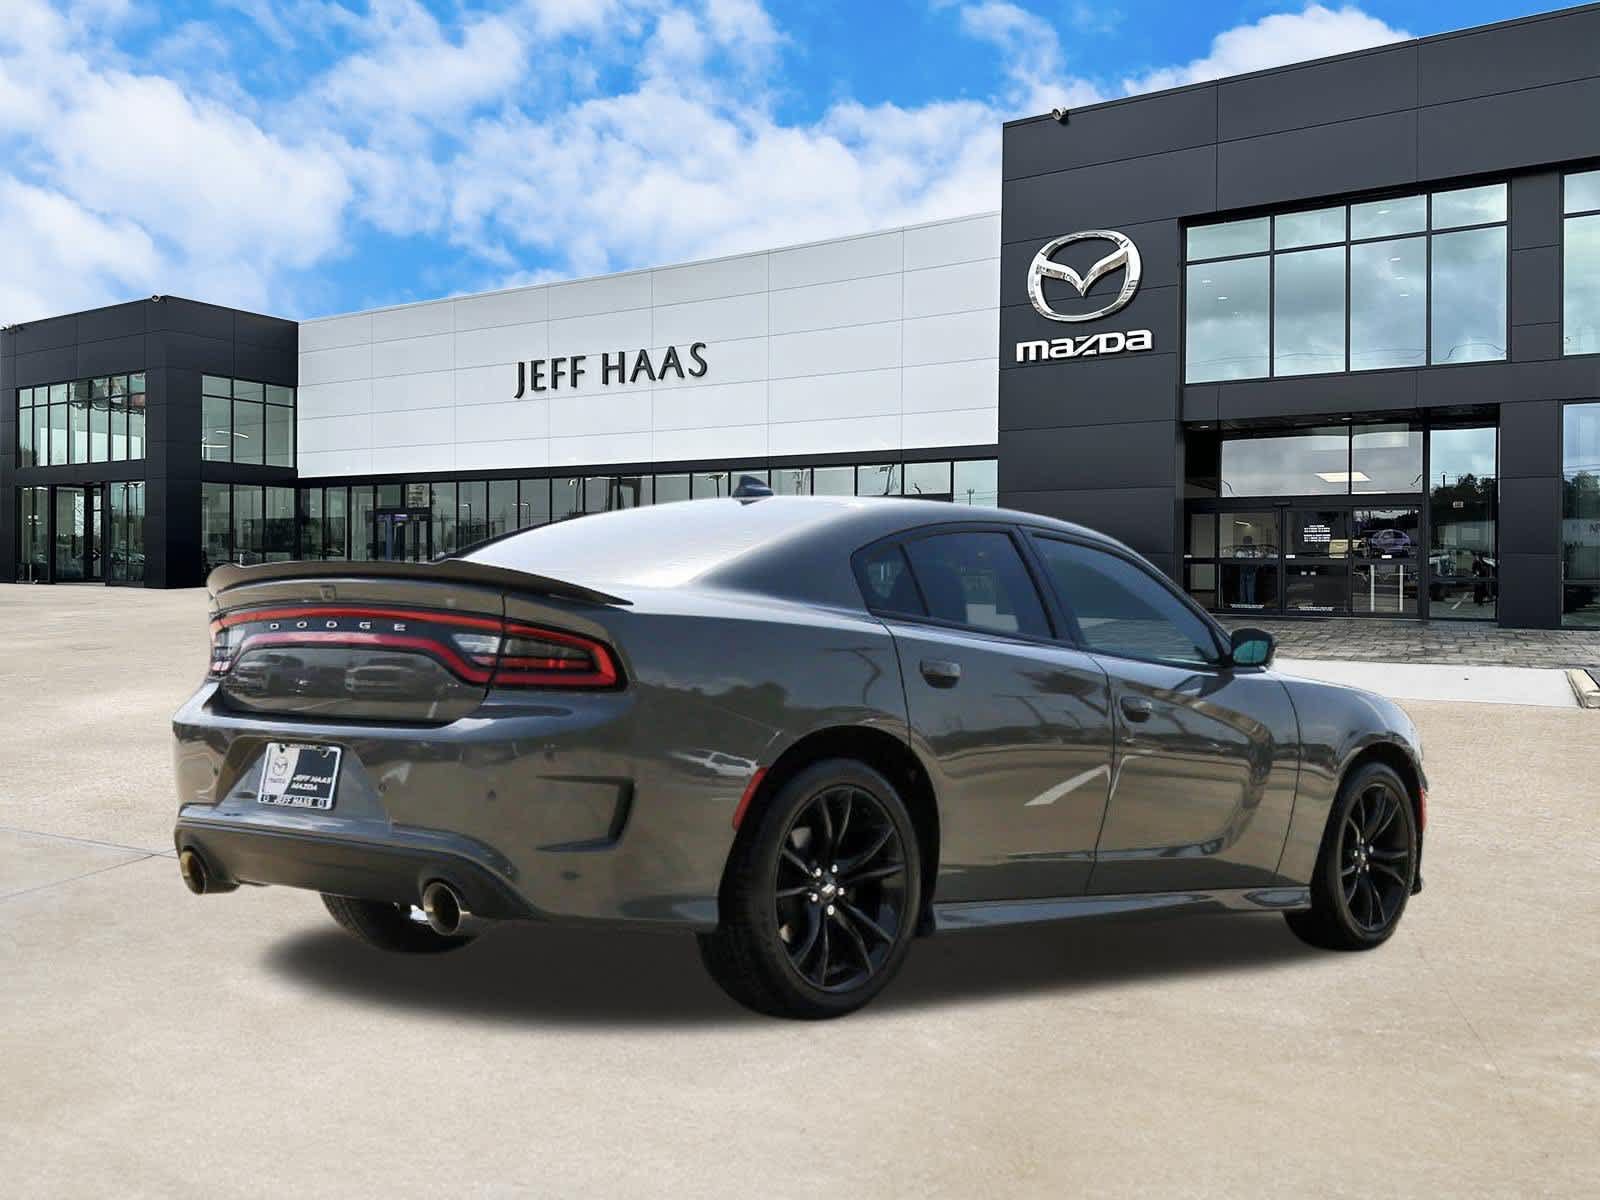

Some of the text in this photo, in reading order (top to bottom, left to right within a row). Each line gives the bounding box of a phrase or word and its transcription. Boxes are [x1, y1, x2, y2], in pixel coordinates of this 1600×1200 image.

[514, 342, 708, 399] JEFF HAAS
[270, 621, 406, 631] DODGE
